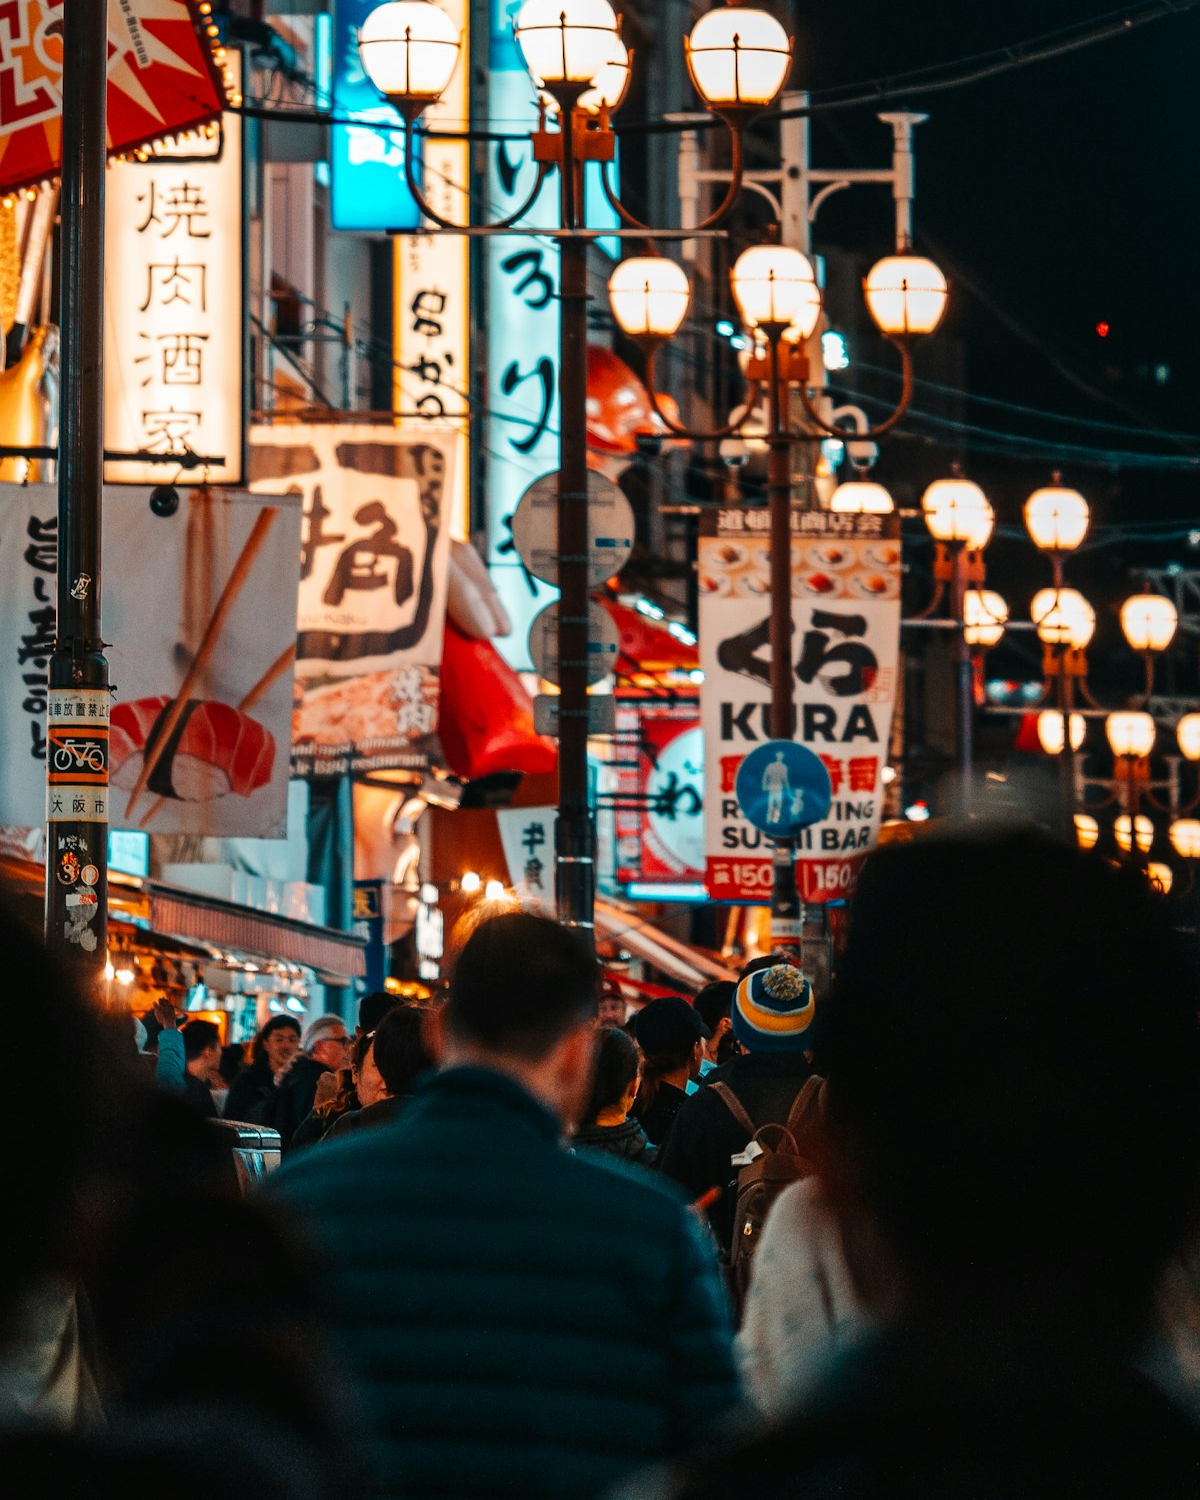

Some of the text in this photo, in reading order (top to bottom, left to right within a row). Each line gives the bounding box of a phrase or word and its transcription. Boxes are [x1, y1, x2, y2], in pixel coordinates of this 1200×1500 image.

[134, 180, 212, 457] 焼肉酒家
[48, 702, 109, 717] 車放置禁止
[52, 799, 105, 814] 大阪市
[821, 827, 871, 850] BAR
